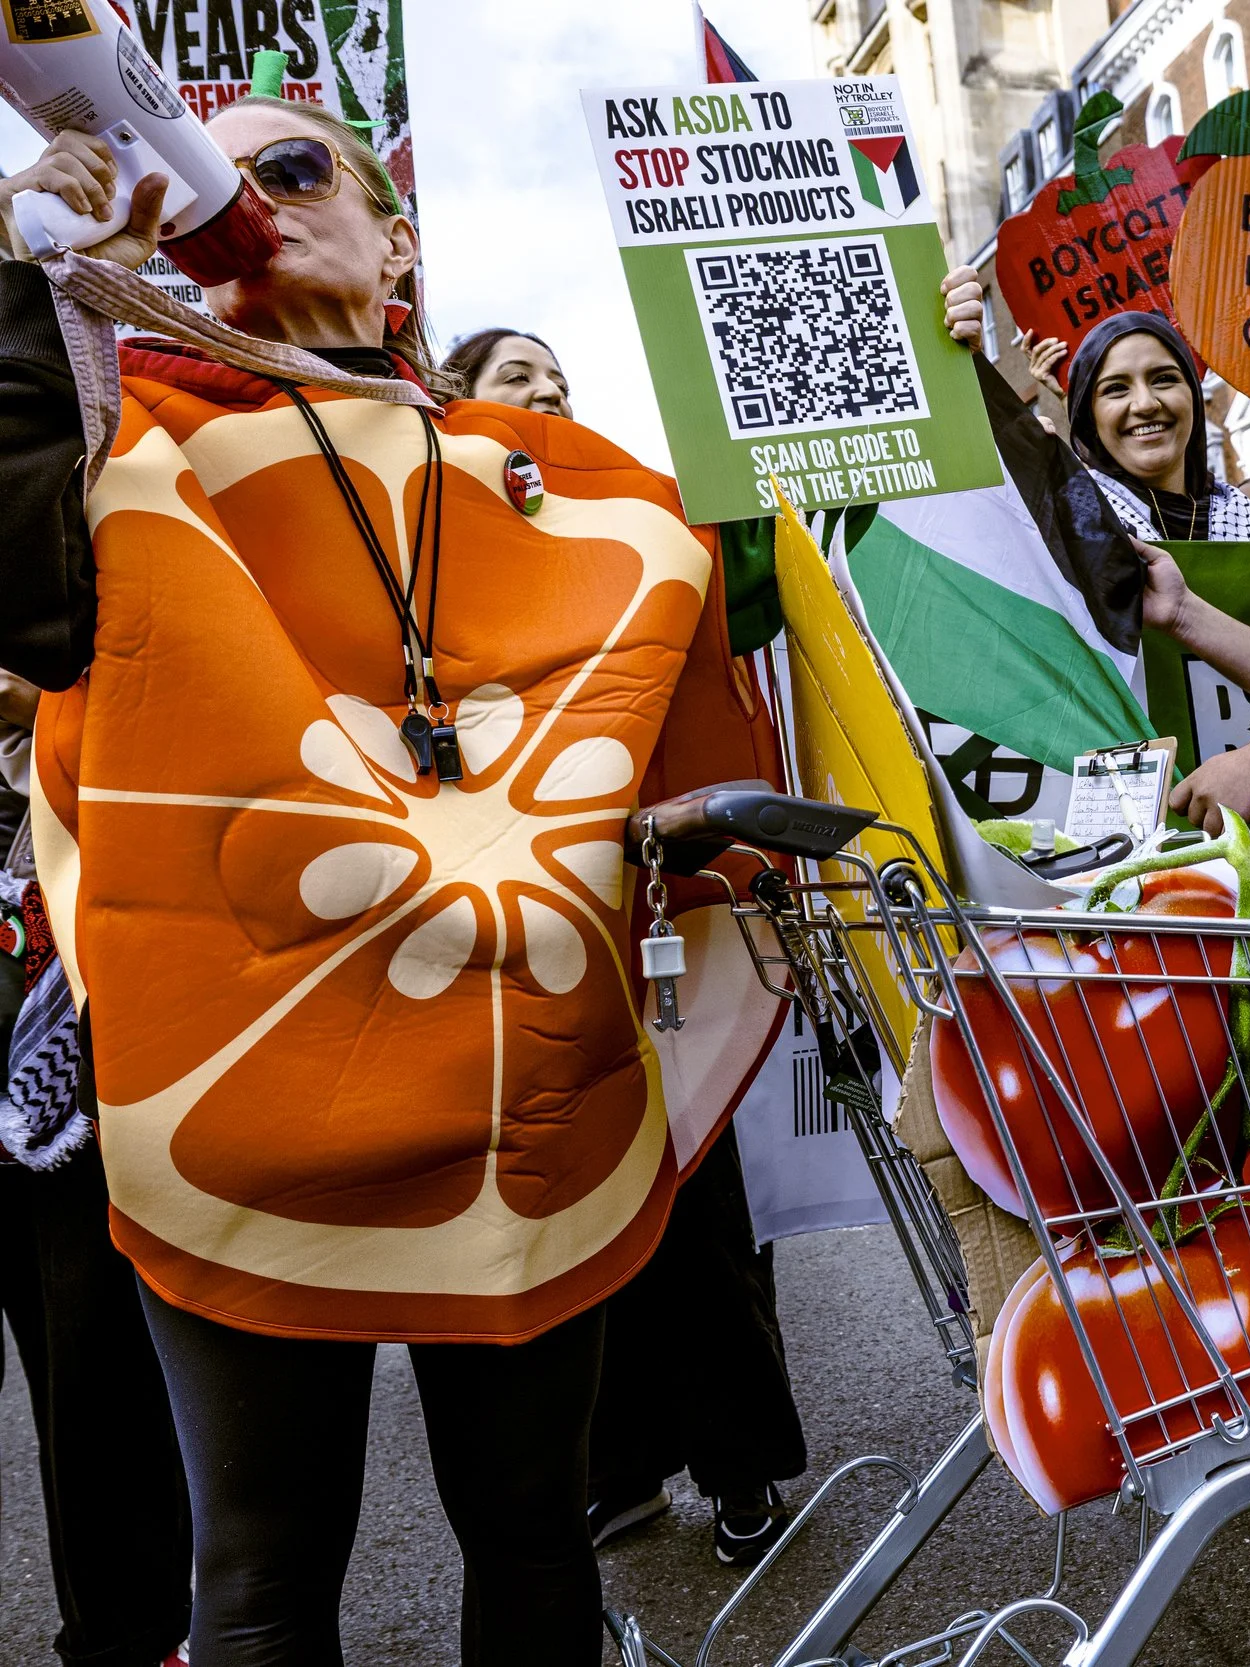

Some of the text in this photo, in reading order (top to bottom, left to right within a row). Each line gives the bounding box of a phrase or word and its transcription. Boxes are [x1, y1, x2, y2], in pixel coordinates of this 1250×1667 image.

[134, 0, 318, 80] YEARS
[125, 67, 159, 111] TAKE A STAND
[833, 82, 875, 95] NOT IN
[836, 92, 893, 103] MY TROLLEY
[605, 91, 792, 139] ASK ASDA TO
[614, 138, 840, 190] STOP STOCKING
[625, 186, 855, 234] ISRAELI PRODUCTS
[1028, 182, 1191, 296] BOYCOTT
[1061, 244, 1172, 329] ISRAE
[750, 428, 921, 476] SCAN QR CODE TO
[513, 480, 542, 494] PALESTINE
[805, 470, 849, 503] THE
[847, 459, 937, 498] PETITION
